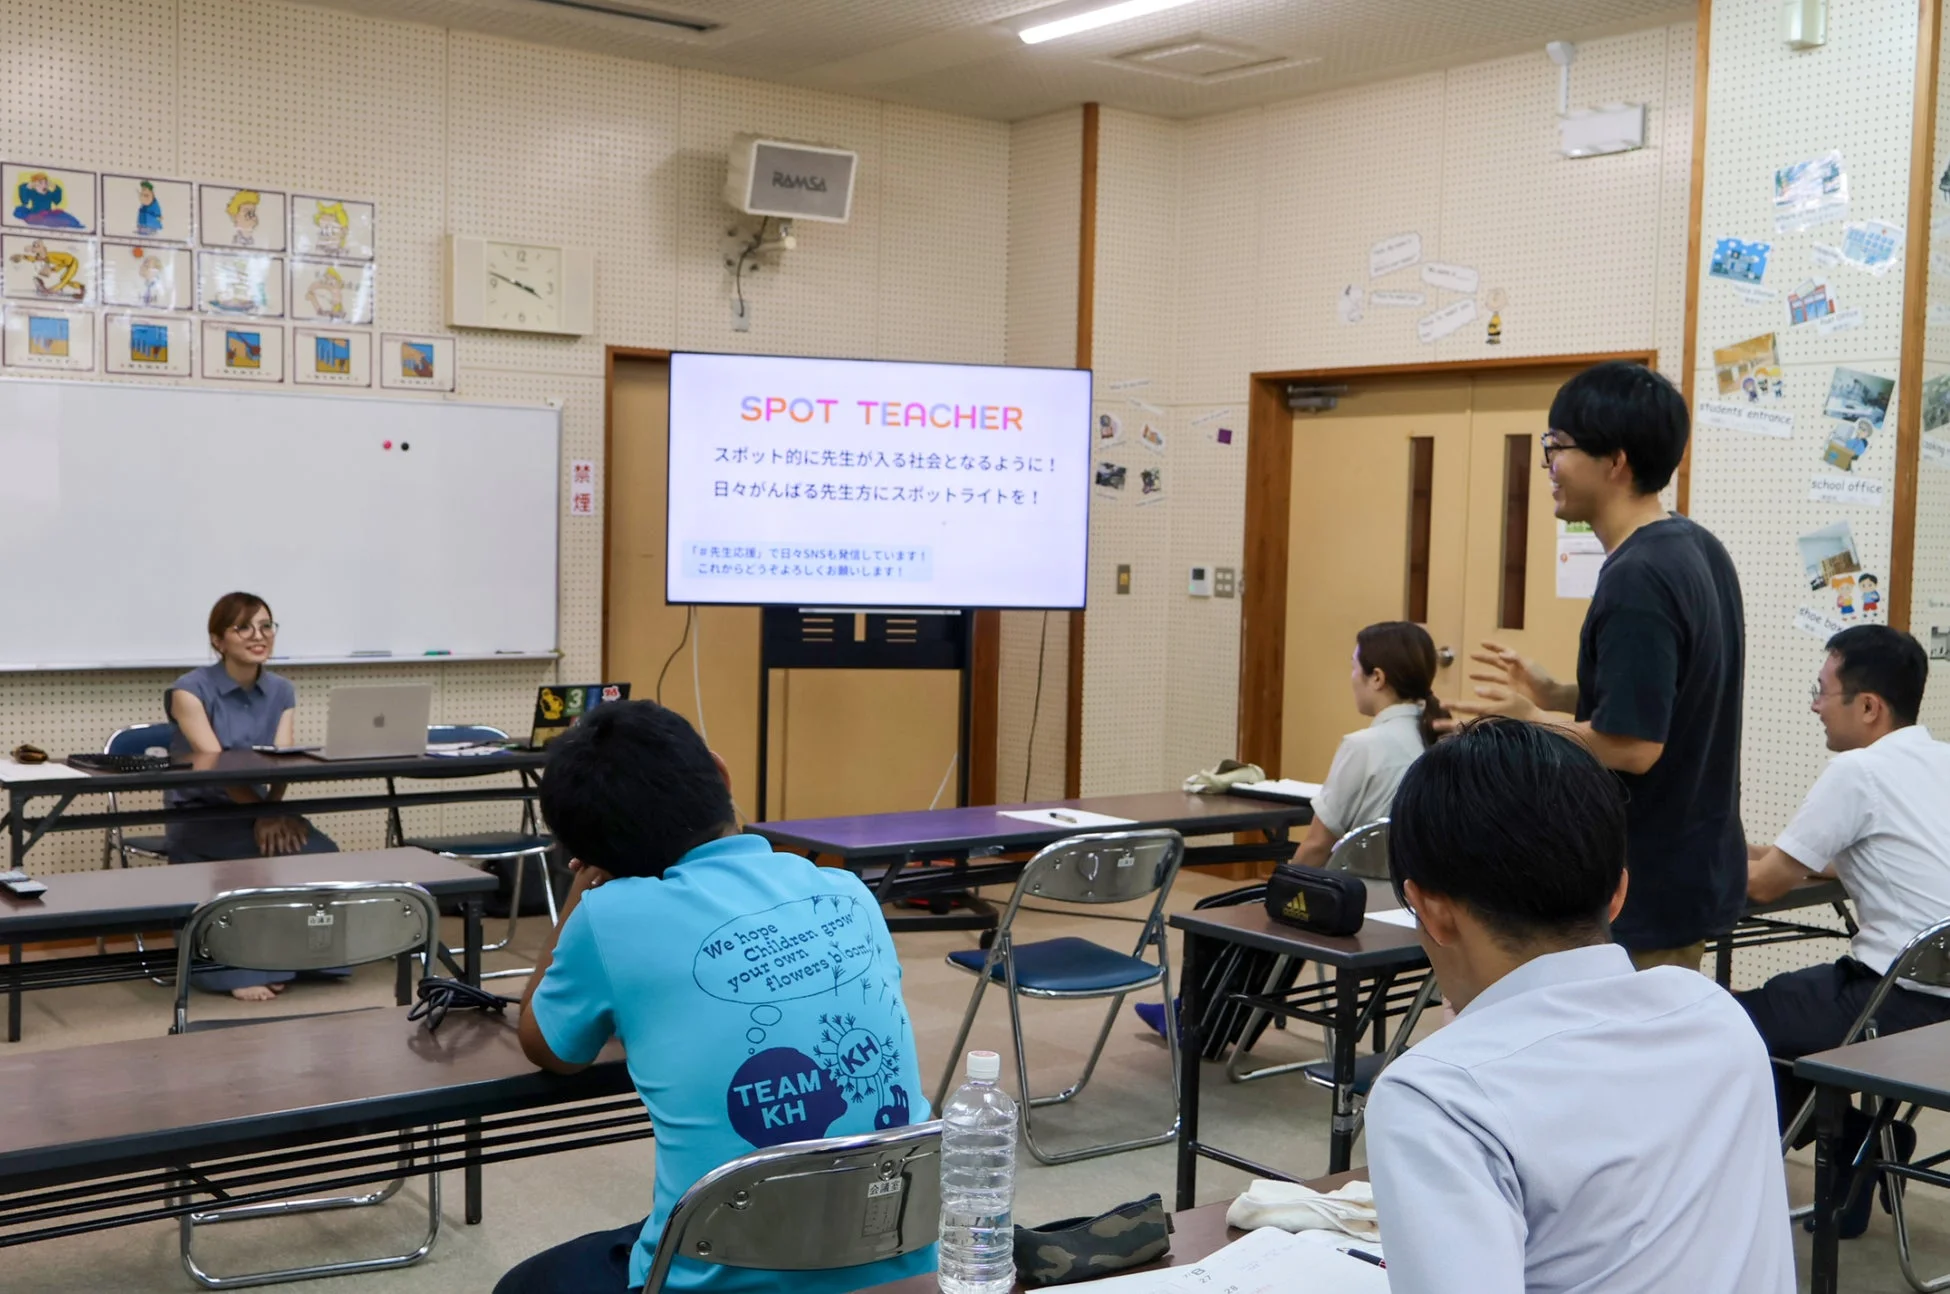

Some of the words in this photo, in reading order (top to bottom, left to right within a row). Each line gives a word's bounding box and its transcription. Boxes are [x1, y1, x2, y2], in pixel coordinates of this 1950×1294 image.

[772, 170, 827, 192] RAMSA
[517, 250, 526, 262] 12
[741, 396, 838, 422] SPOT
[857, 400, 1023, 430] TEACHER
[1746, 410, 1792, 424] entrance
[574, 463, 592, 513] 禁煙
[1811, 480, 1845, 491] school
[1848, 480, 1883, 494] office
[703, 939, 735, 960] We
[734, 922, 778, 946] hope
[744, 928, 818, 962] Children
[821, 913, 854, 937] grow
[728, 960, 771, 993] your
[773, 949, 809, 969] own
[765, 958, 830, 993] flowers
[840, 1035, 879, 1074] KH
[733, 1069, 822, 1107] TEAM
[761, 1100, 806, 1129] KH
[1200, 1274, 1212, 1283] 27
